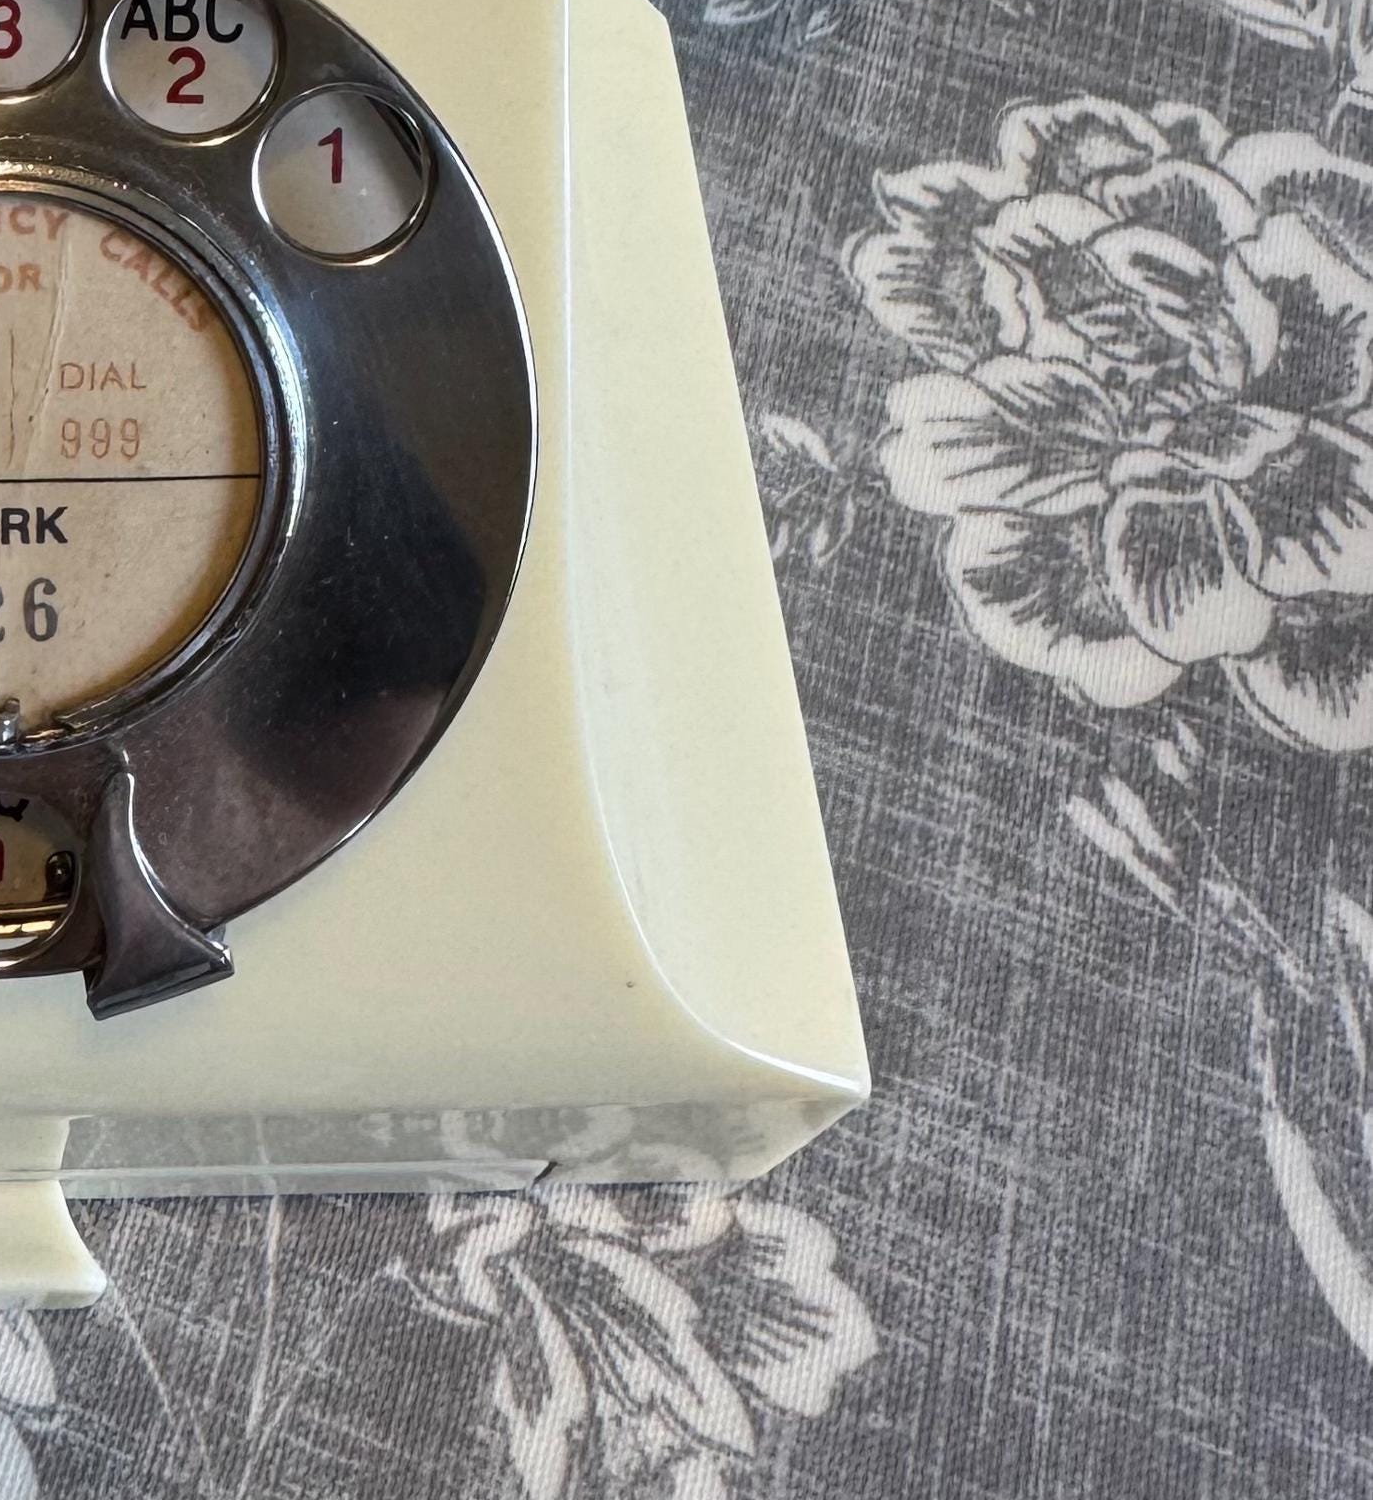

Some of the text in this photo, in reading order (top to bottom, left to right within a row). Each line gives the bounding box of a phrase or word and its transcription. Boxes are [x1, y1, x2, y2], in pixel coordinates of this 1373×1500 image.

[166, 46, 206, 104] 2
[318, 126, 344, 184] 1
[99, 227, 210, 333] CALLS
[60, 361, 147, 391] DIAL
[61, 417, 141, 459] 999
